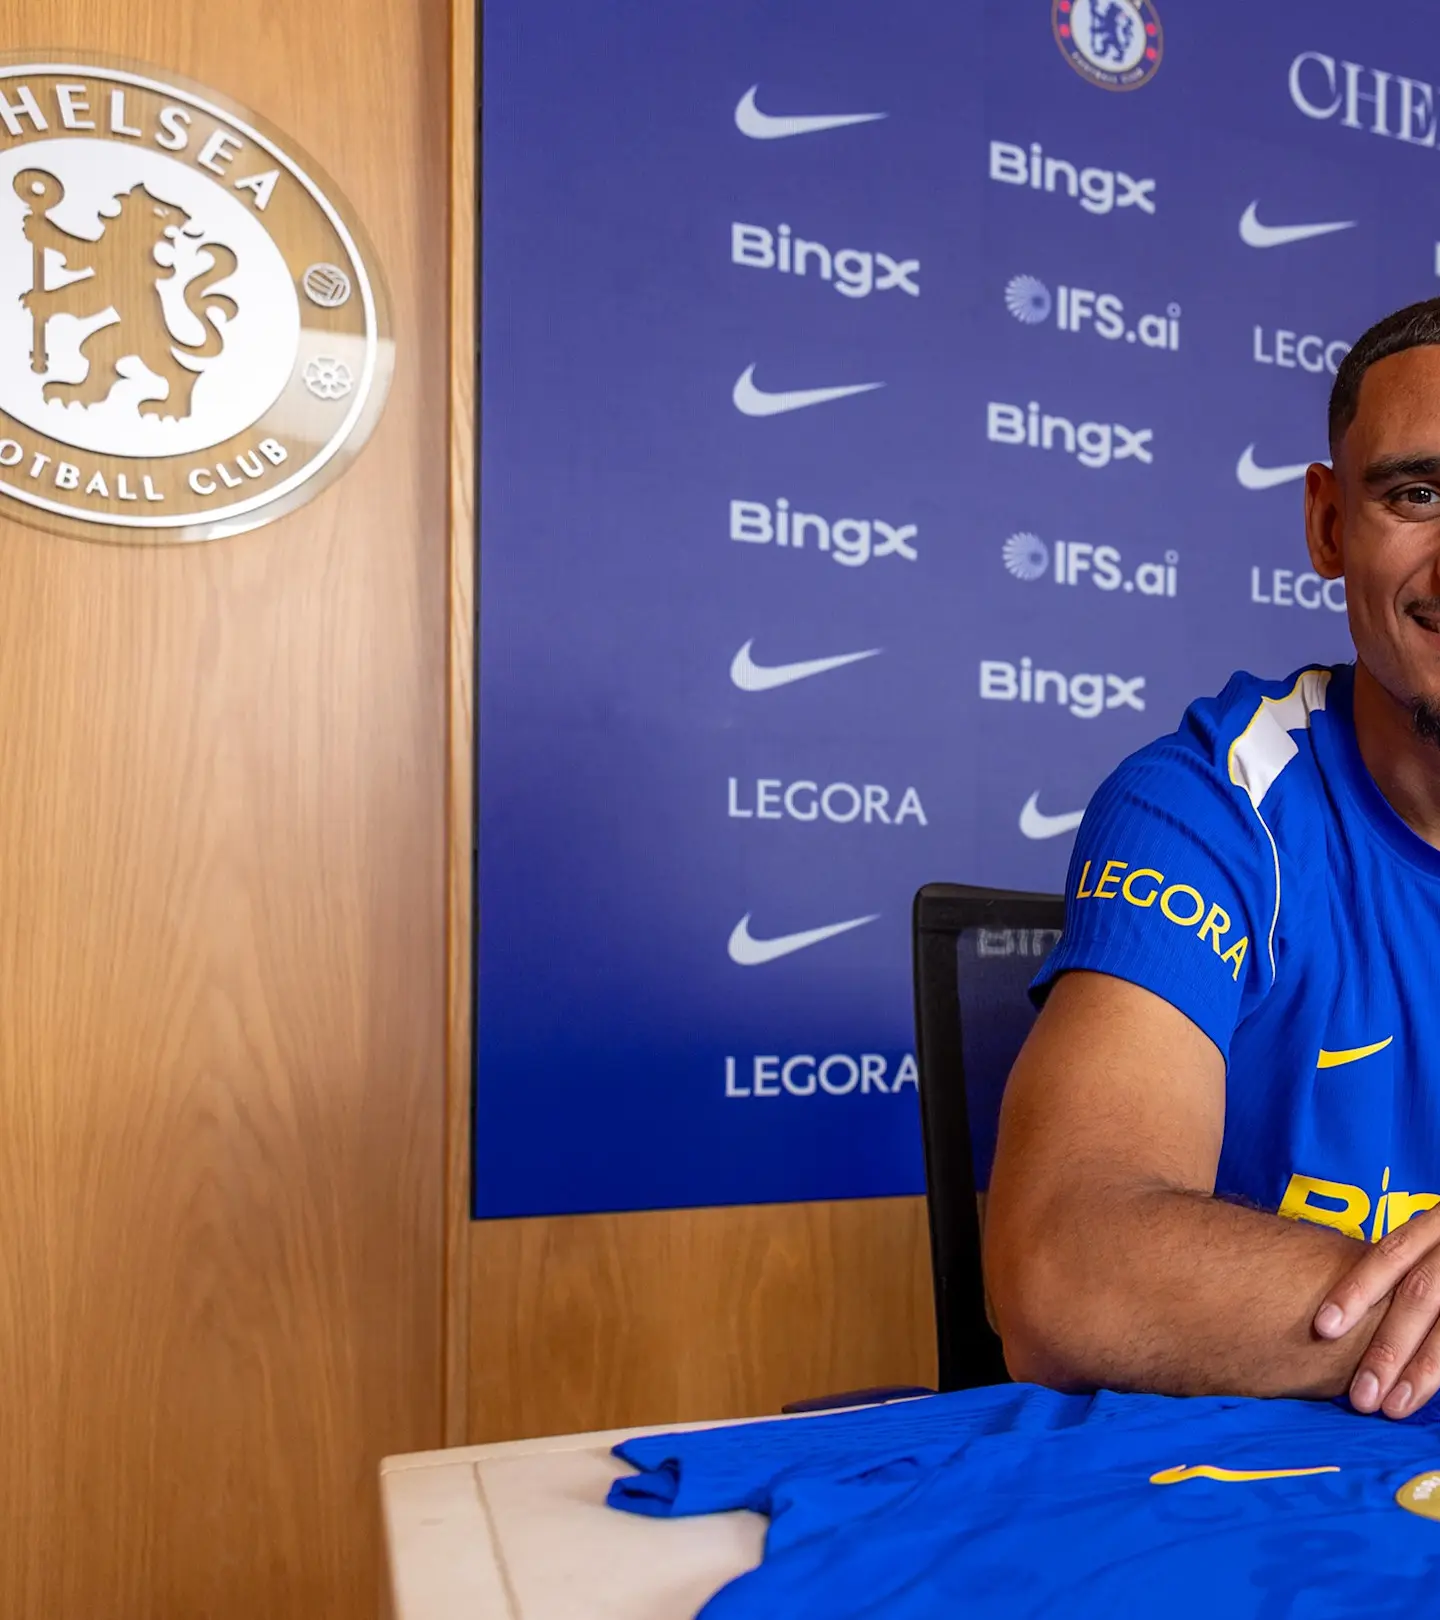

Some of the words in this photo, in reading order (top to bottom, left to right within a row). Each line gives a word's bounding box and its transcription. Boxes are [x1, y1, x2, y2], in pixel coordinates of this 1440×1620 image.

[0, 84, 281, 211] HELSEA
[1057, 285, 1180, 351] IFS.ai
[1253, 325, 1351, 375] LEGO
[0, 439, 163, 501] OTBALL
[188, 438, 288, 495] CLUB
[1054, 540, 1178, 597] IFS.ai
[1251, 566, 1347, 612] LEGO
[728, 777, 928, 826] LEGORA
[1076, 860, 1249, 981] LEGORA
[725, 1053, 919, 1098] LEGORA
